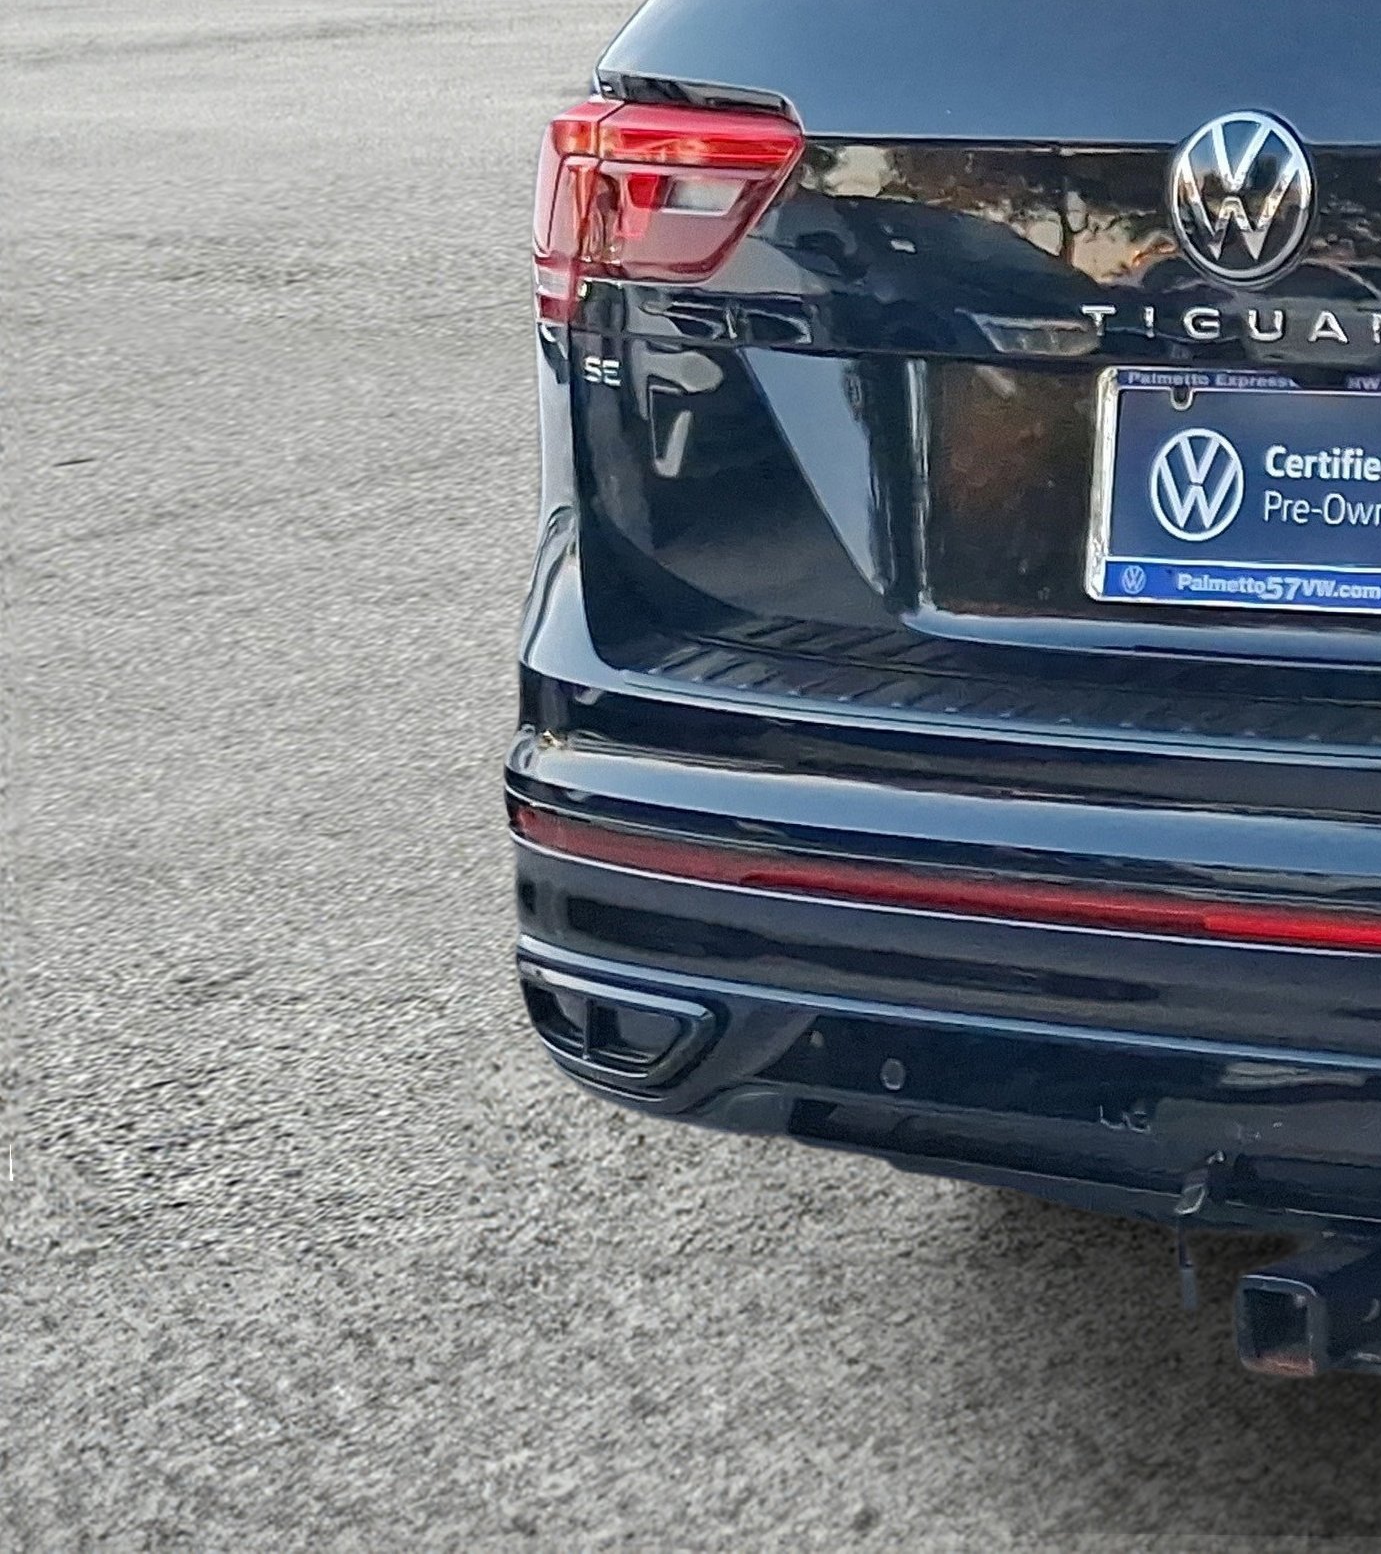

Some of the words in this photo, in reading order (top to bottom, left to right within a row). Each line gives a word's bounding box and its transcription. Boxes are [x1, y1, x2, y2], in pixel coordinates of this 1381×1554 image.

[1175, 114, 1310, 272] VW
[584, 356, 621, 386] SE
[1127, 371, 1210, 386] Palmetto
[1151, 430, 1243, 539] VW
[1177, 572, 1381, 602] Palmetto57VW.com
